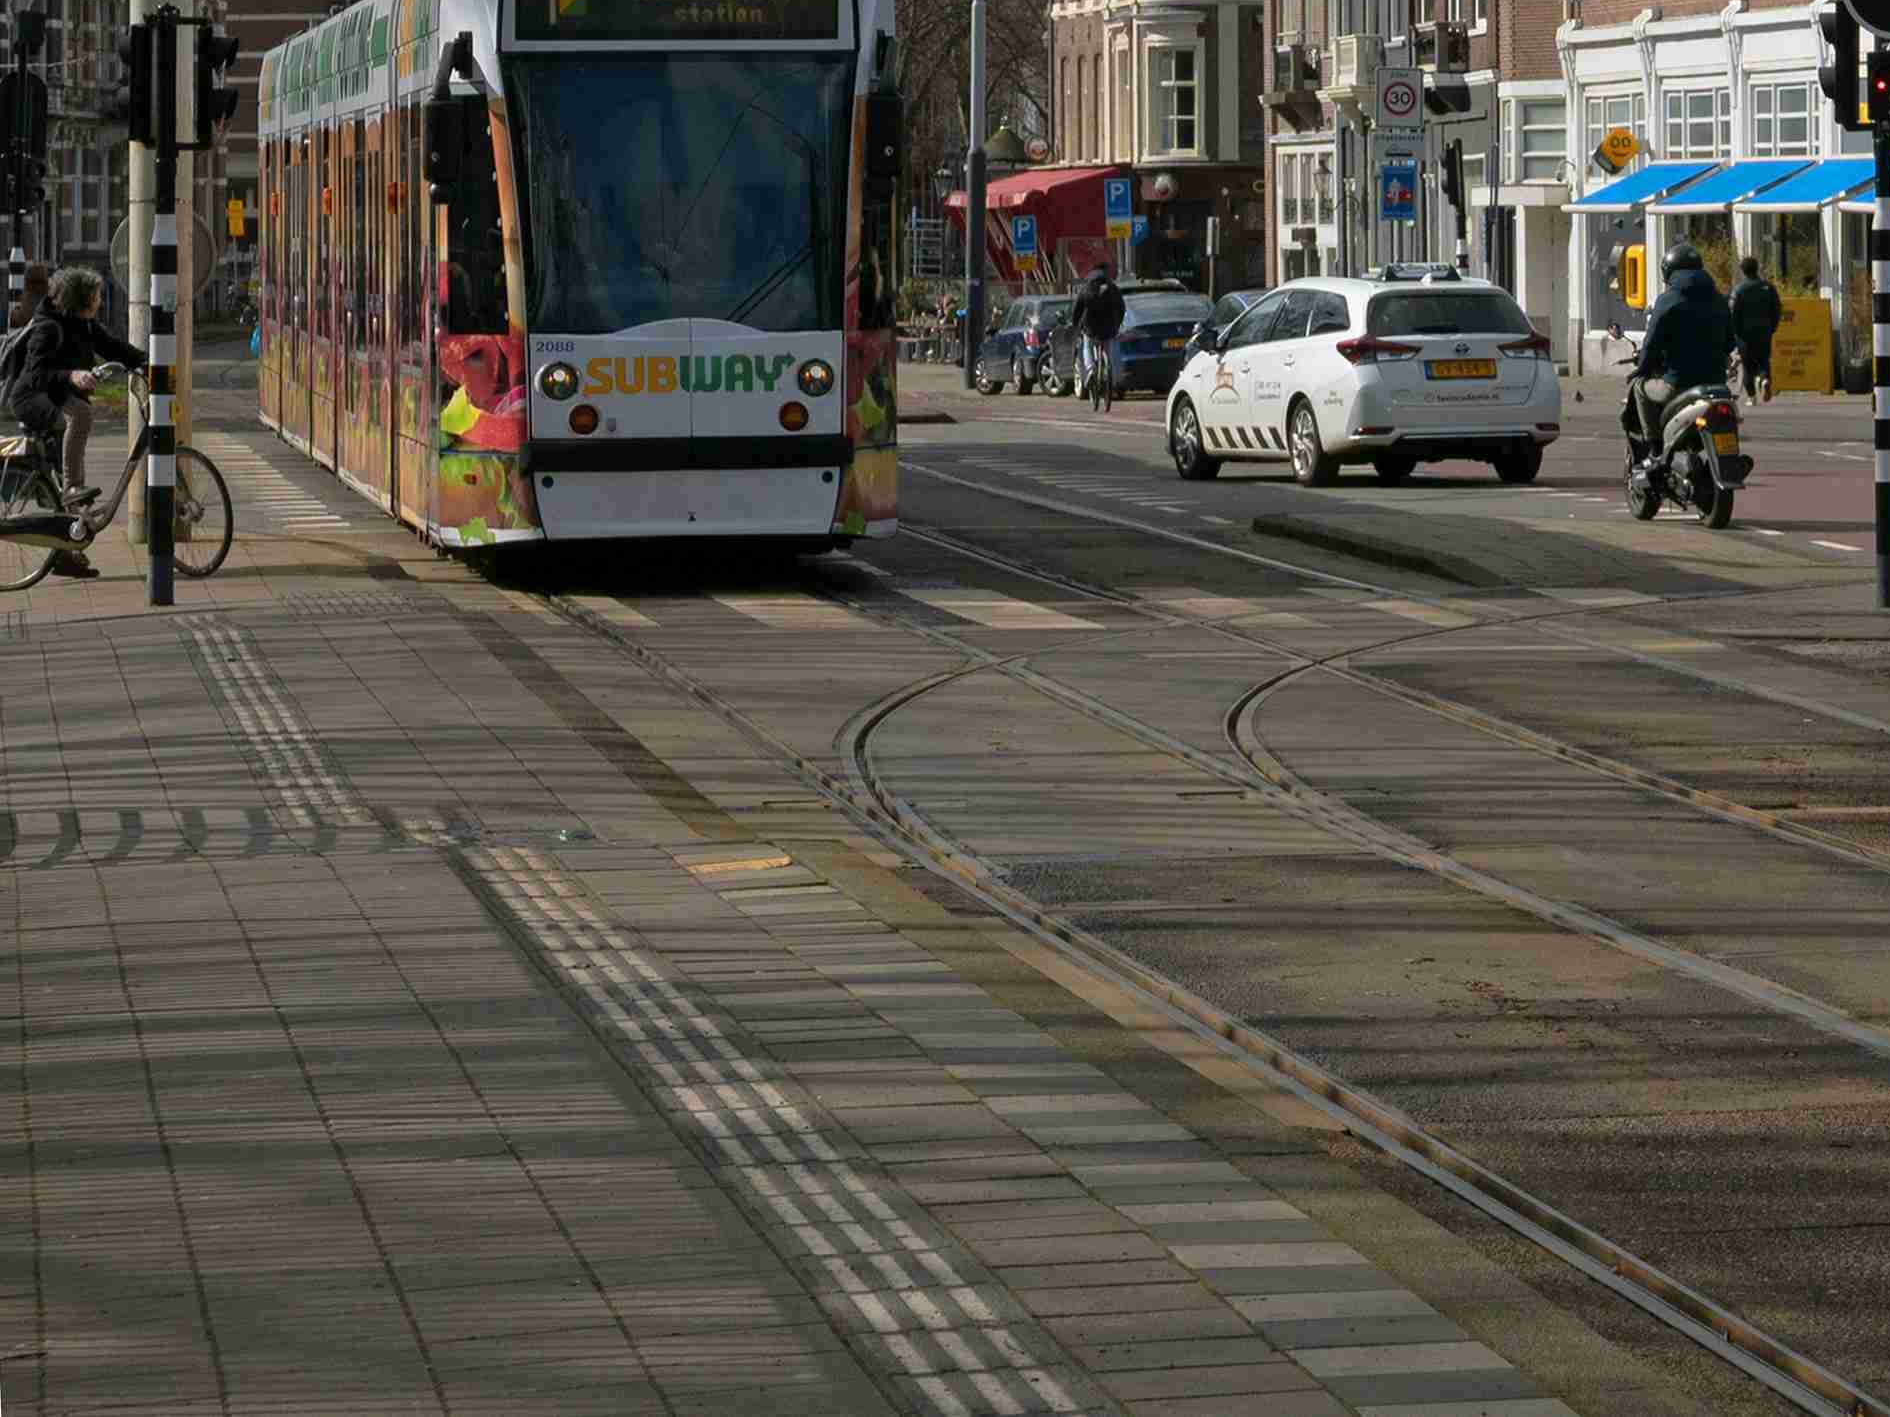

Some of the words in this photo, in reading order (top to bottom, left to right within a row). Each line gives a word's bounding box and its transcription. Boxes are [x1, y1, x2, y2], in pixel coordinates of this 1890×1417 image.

[1389, 91, 1410, 105] 30
[1110, 182, 1125, 203] P
[1017, 219, 1031, 238] P
[535, 341, 575, 353] 2088
[583, 352, 796, 397] SUBWAY
